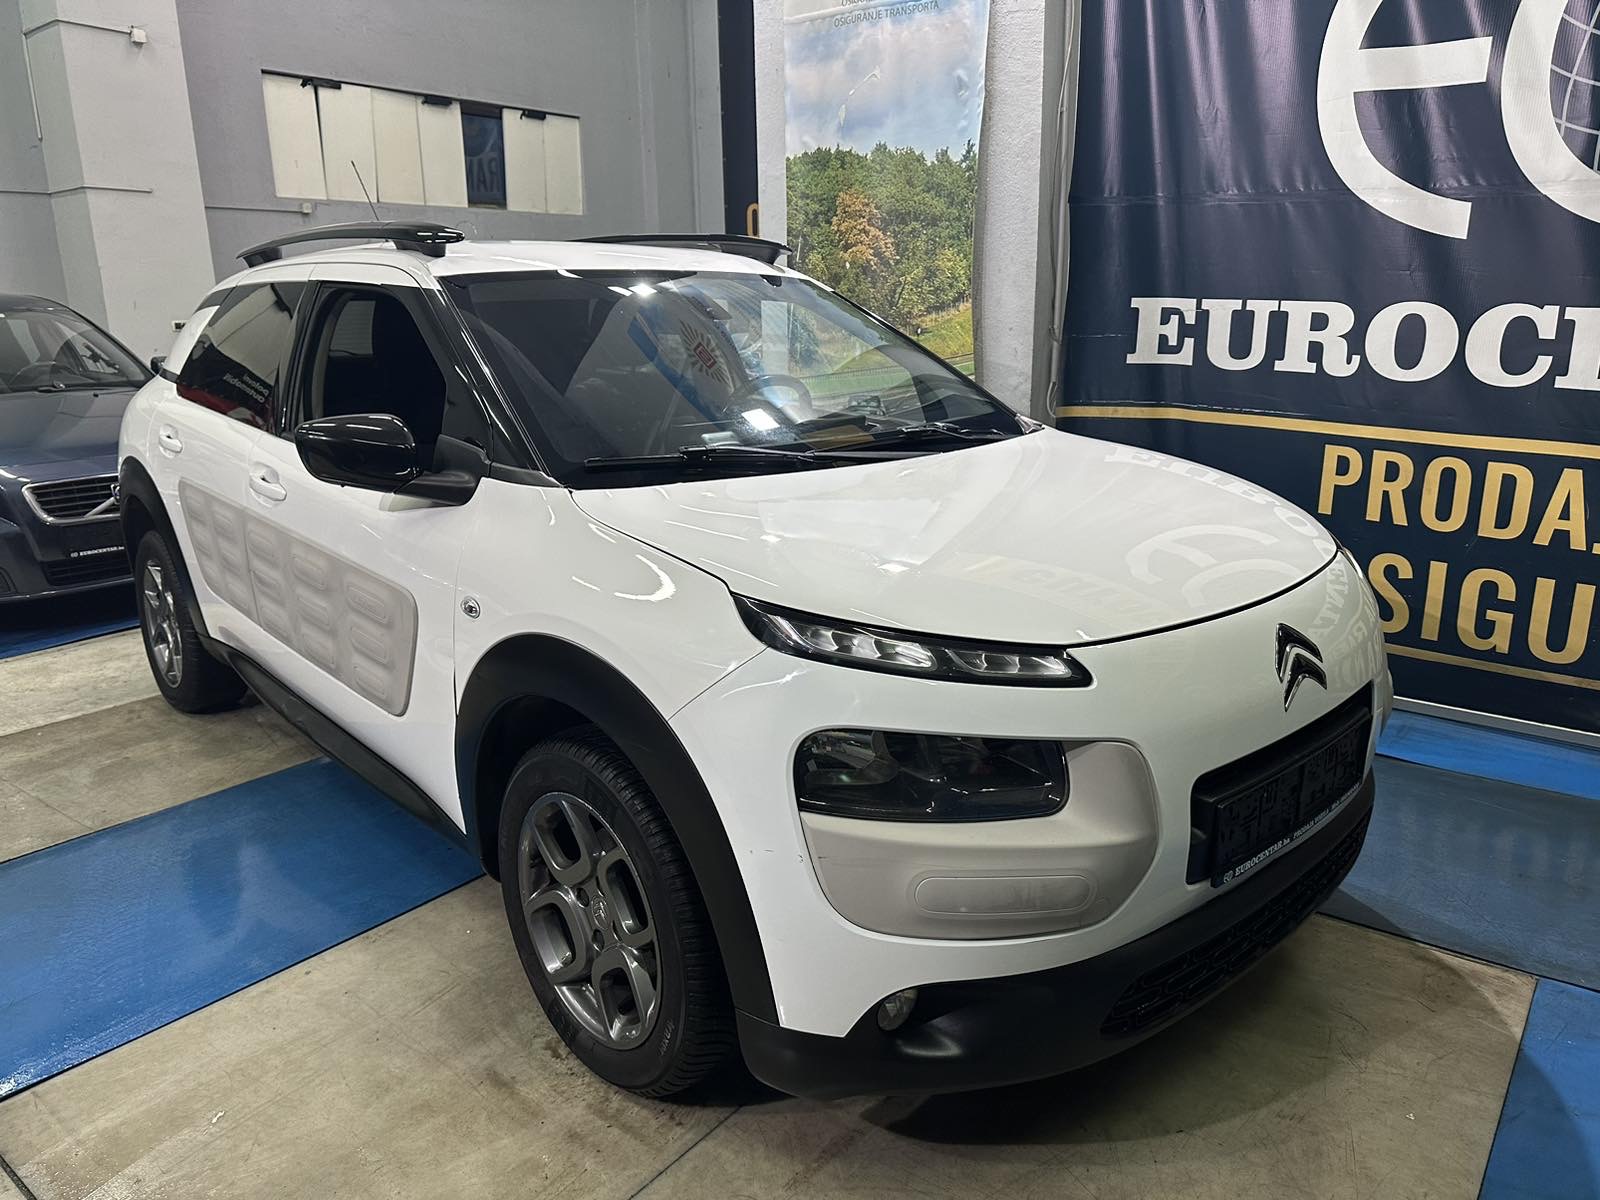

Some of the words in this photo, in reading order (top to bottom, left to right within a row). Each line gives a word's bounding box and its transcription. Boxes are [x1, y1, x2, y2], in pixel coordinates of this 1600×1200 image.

[834, 11, 883, 28] OSIGURANJE
[885, 1, 939, 18] TRANSPORTA
[1318, 444, 1600, 555] PRODA
[1368, 552, 1597, 665] SIGU
